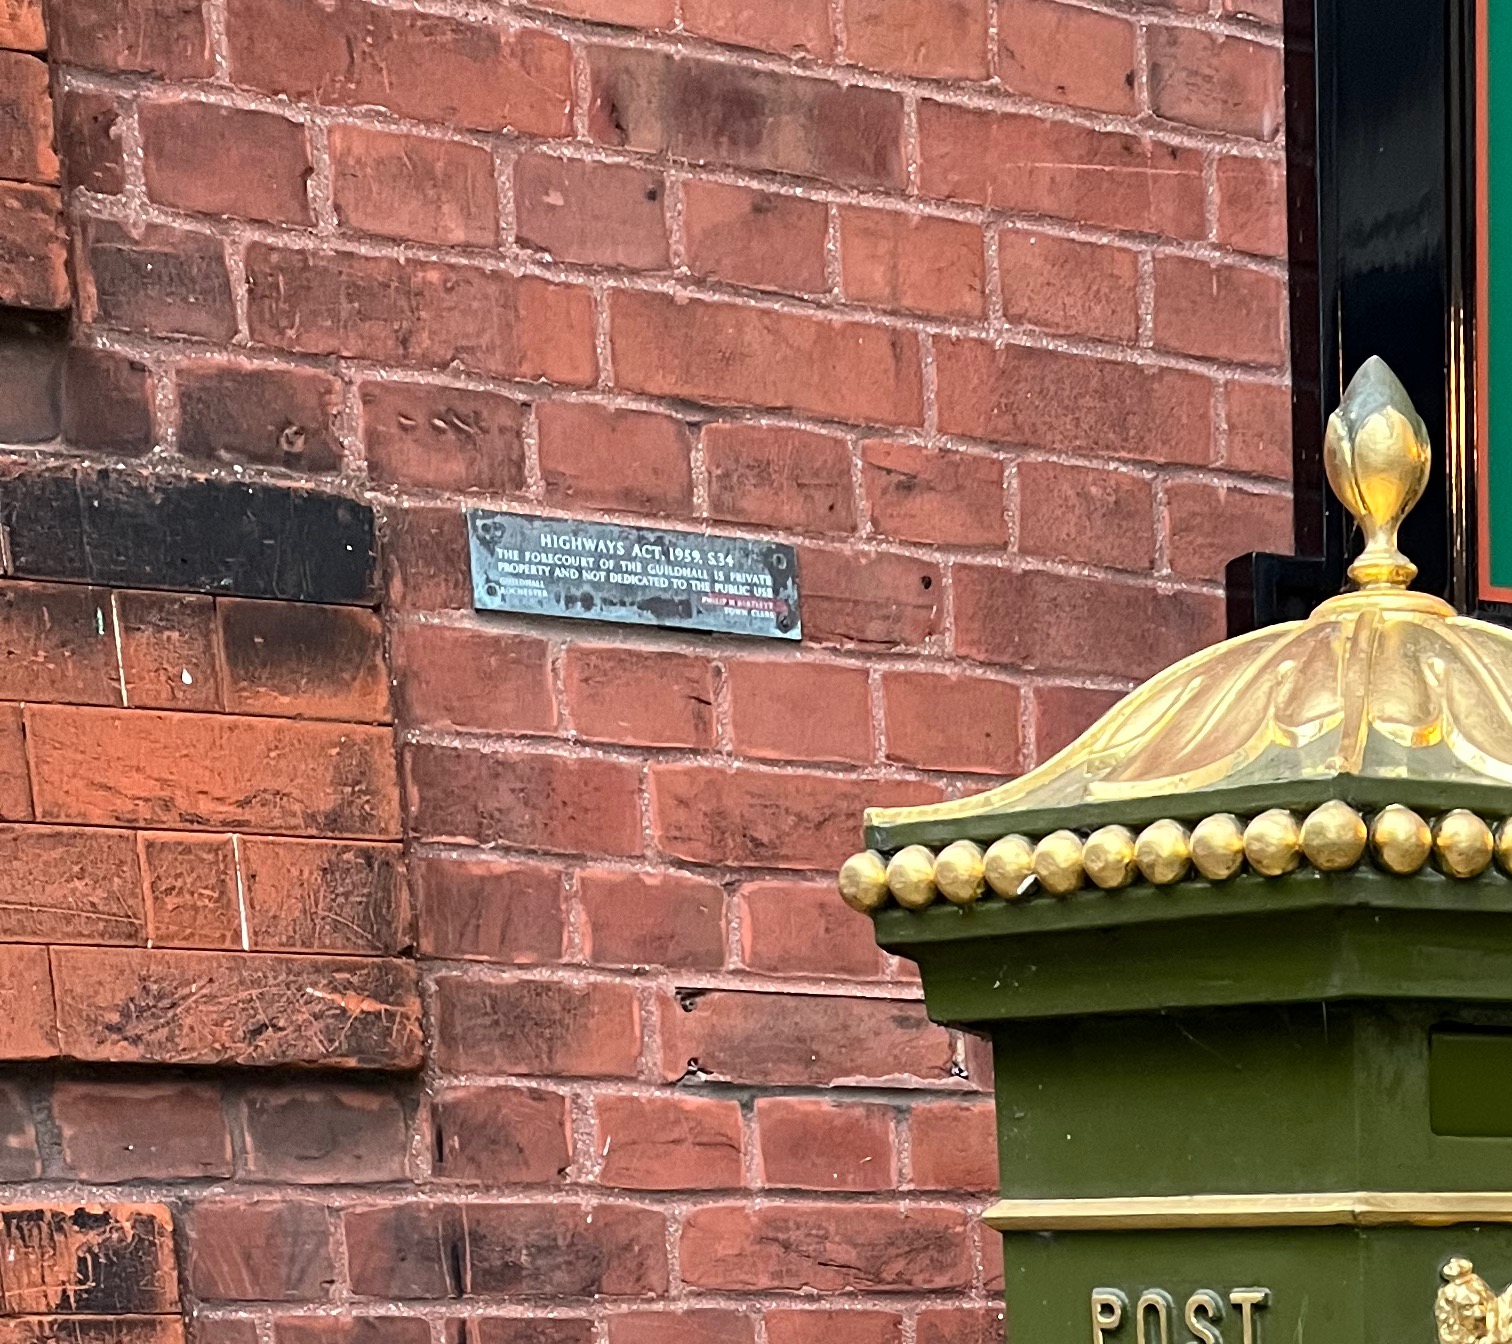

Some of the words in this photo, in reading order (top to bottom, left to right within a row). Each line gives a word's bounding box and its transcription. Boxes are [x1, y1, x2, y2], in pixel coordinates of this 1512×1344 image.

[541, 533, 625, 556] HIGHWAYS
[496, 548, 519, 561] THE
[525, 551, 595, 568] FORECOURT
[599, 558, 614, 570] OF
[620, 560, 643, 573] THE
[647, 563, 708, 580] GUILDHALL
[713, 570, 725, 581] IS
[730, 571, 773, 586] PRIVATE
[497, 561, 551, 577] PROPERTY
[554, 566, 579, 580] AND
[582, 569, 606, 582] NOT
[609, 572, 669, 588] DEDICATED
[671, 578, 687, 590] TO
[690, 579, 710, 592] THE
[714, 583, 751, 596] PUBLIC
[753, 586, 774, 599] USE
